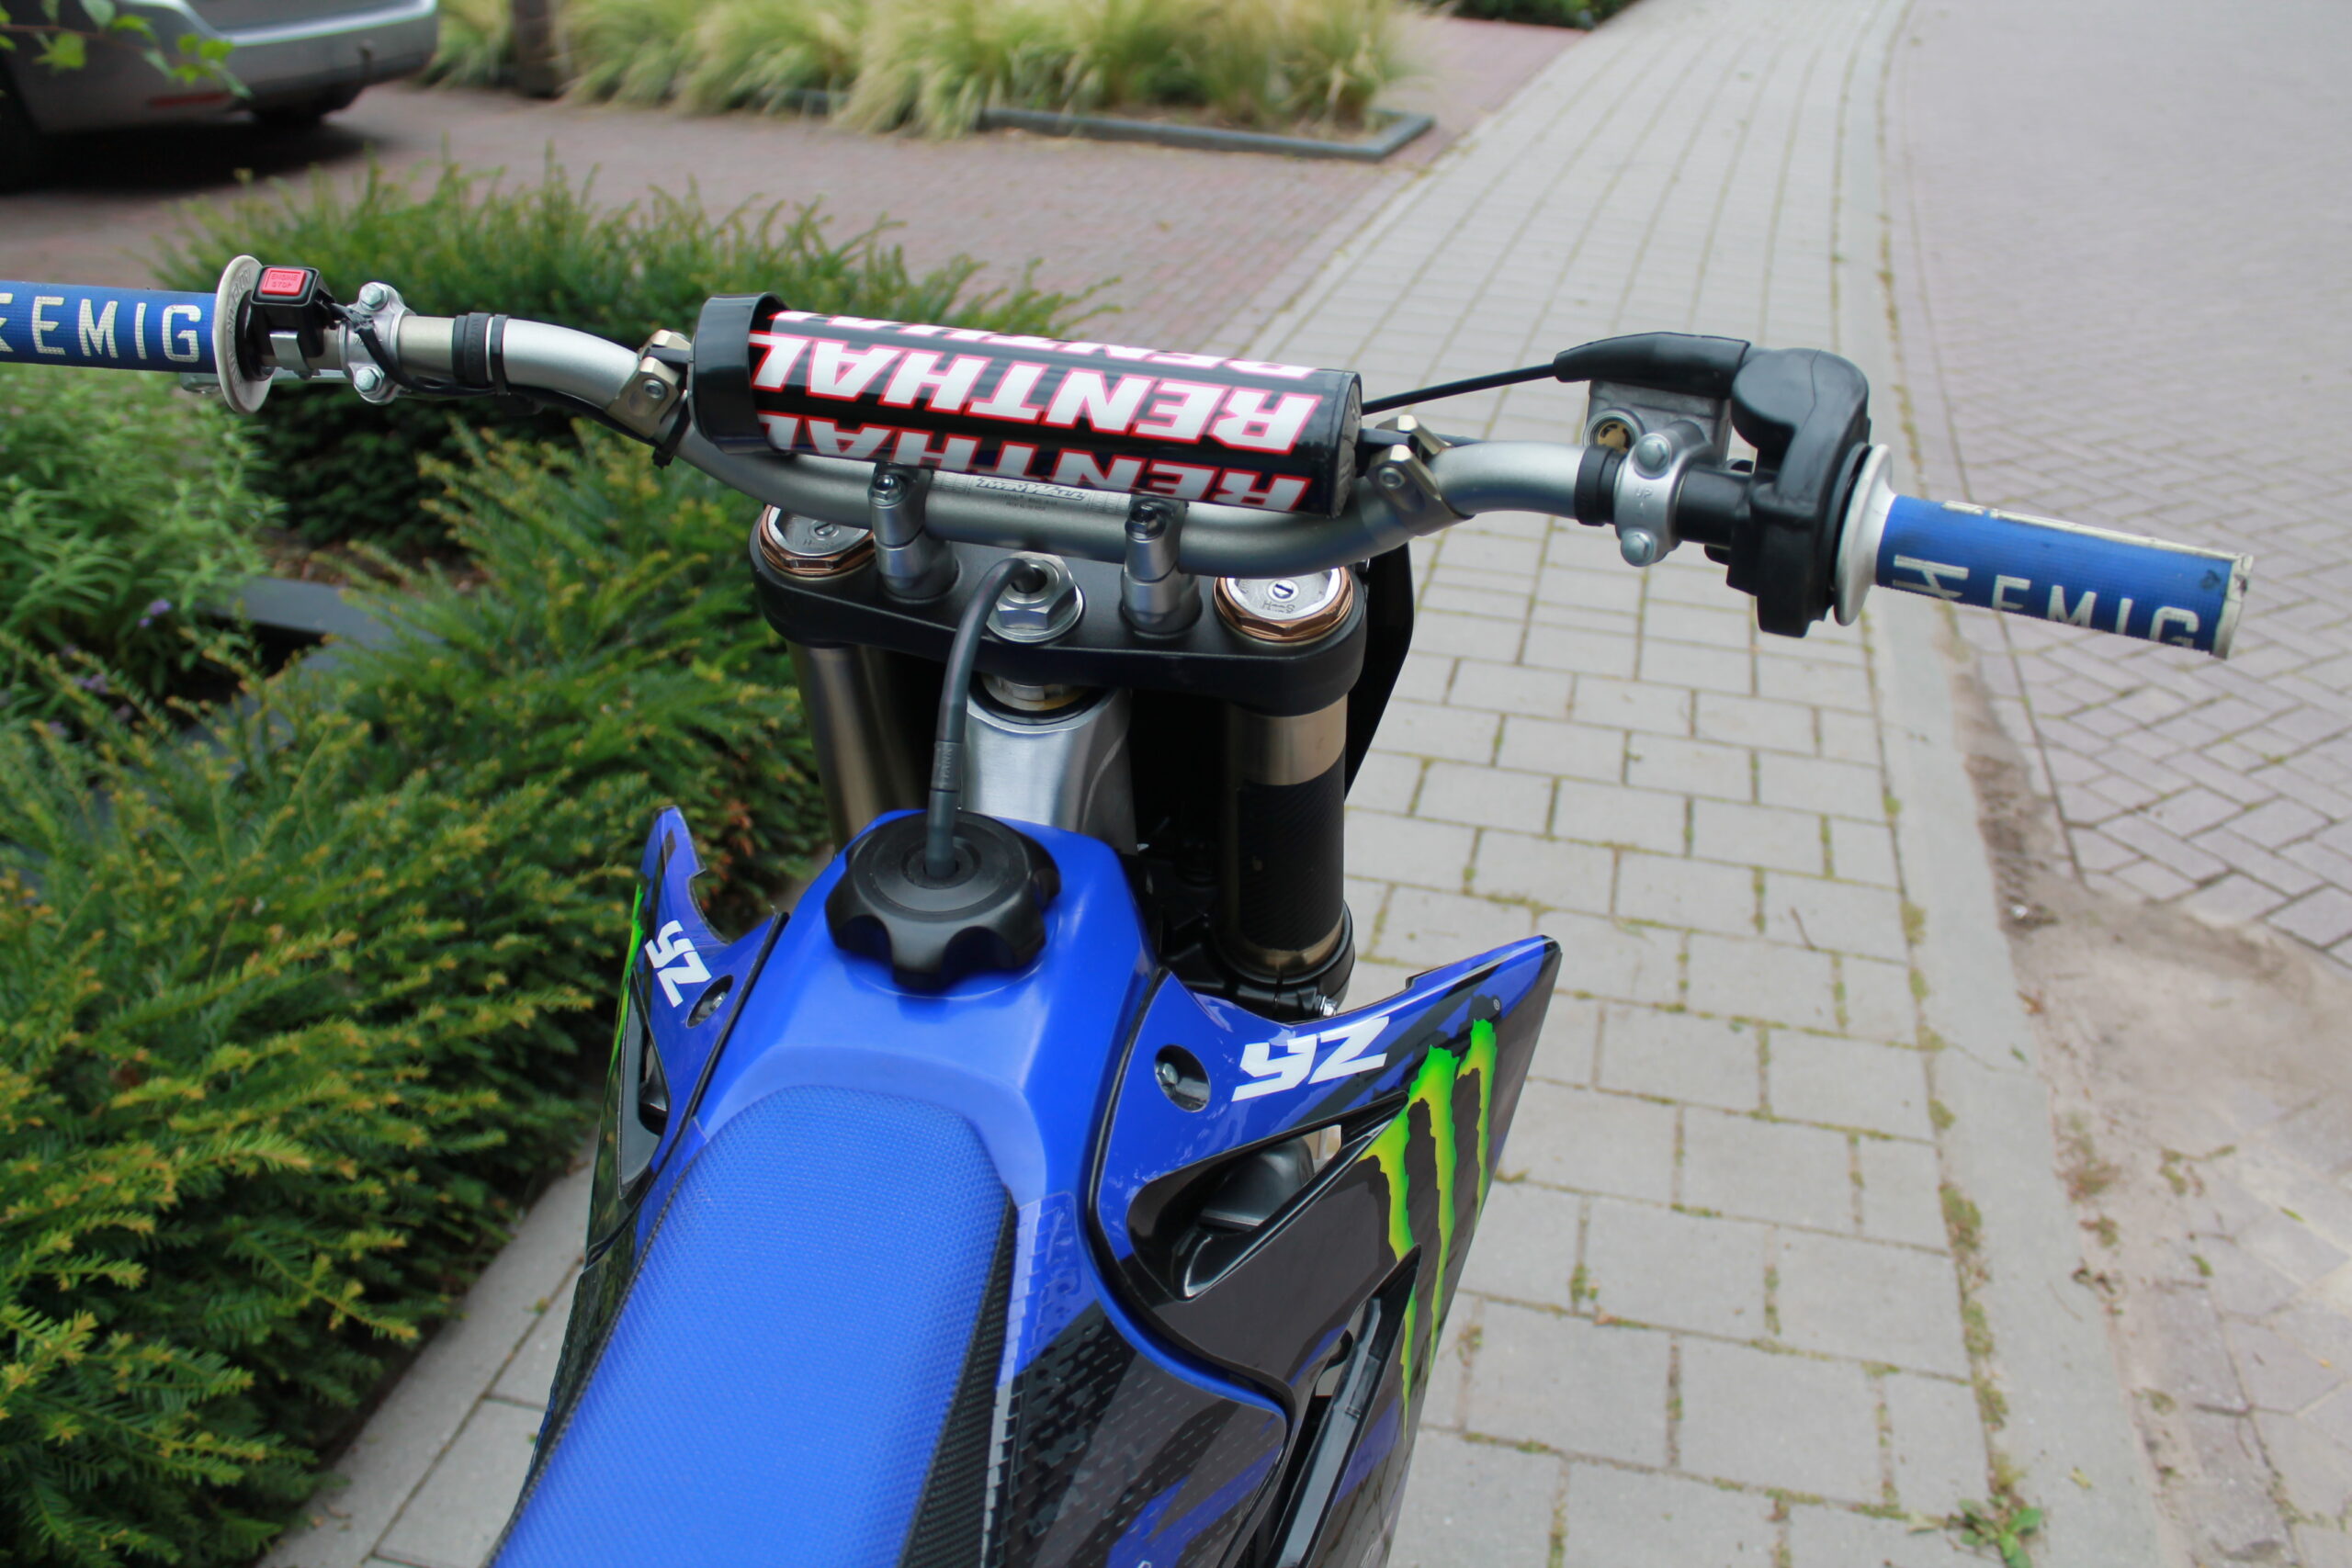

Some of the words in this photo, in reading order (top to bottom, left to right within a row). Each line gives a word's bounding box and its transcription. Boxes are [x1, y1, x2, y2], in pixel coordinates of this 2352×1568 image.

[748, 330, 1323, 456] RENTHAL
[645, 919, 712, 1008] YZ
[1231, 1016, 1389, 1102] YZ
